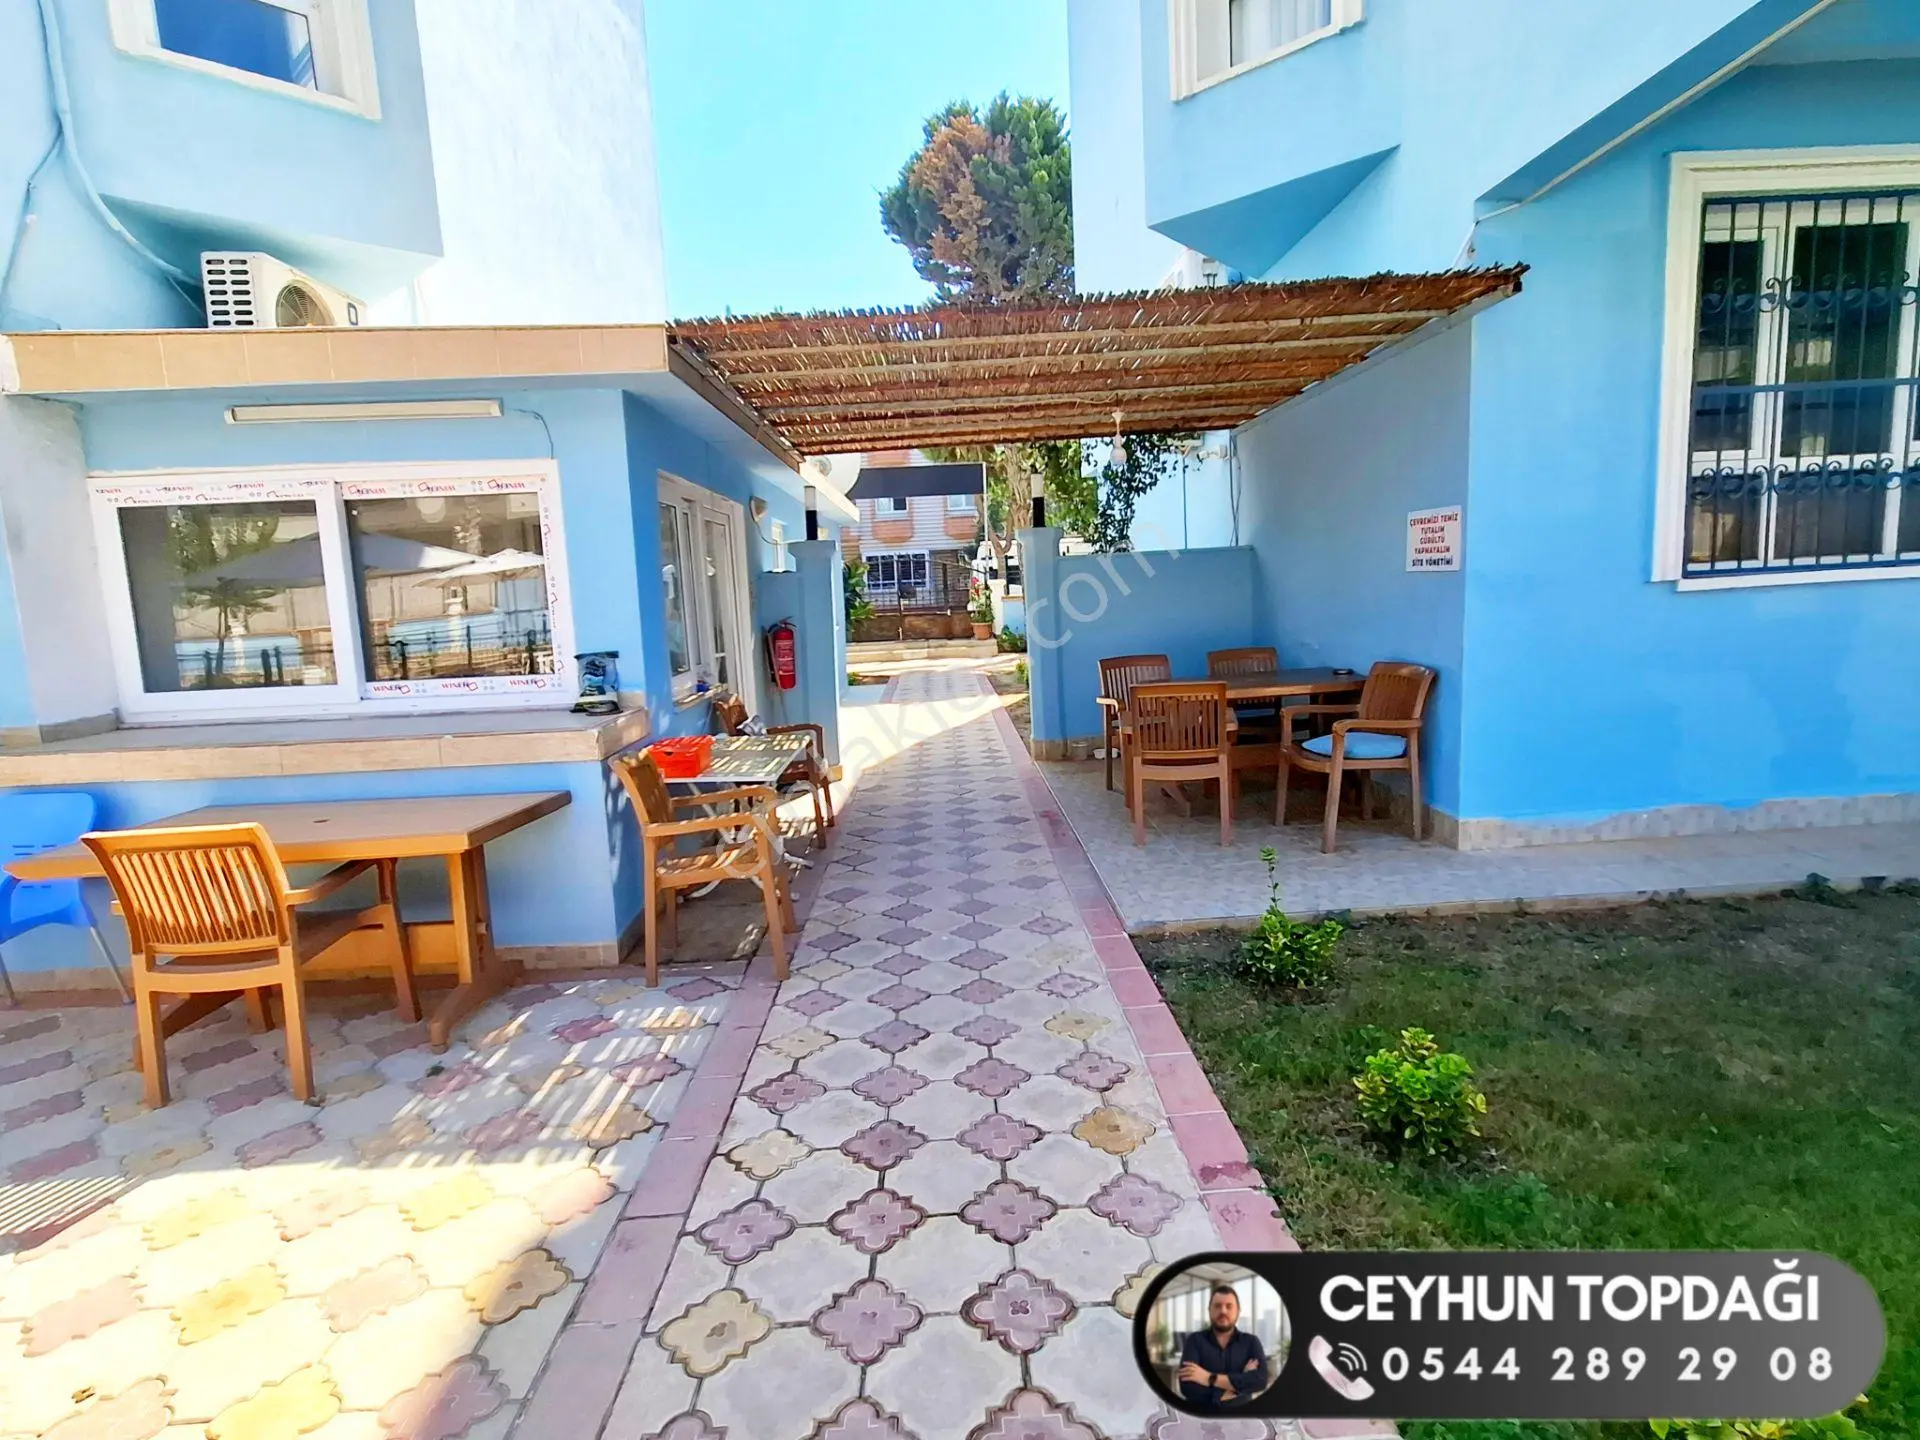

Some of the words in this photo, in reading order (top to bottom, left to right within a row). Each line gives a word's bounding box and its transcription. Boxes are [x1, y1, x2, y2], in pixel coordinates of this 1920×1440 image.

[1409, 514, 1439, 527] ÇEVREMİZİ
[1440, 511, 1459, 523] TEMİZ
[1421, 525, 1445, 535] TUTALIM
[1414, 546, 1451, 555] YAPMAYALIM
[1425, 555, 1453, 566] YÖNETİMİ
